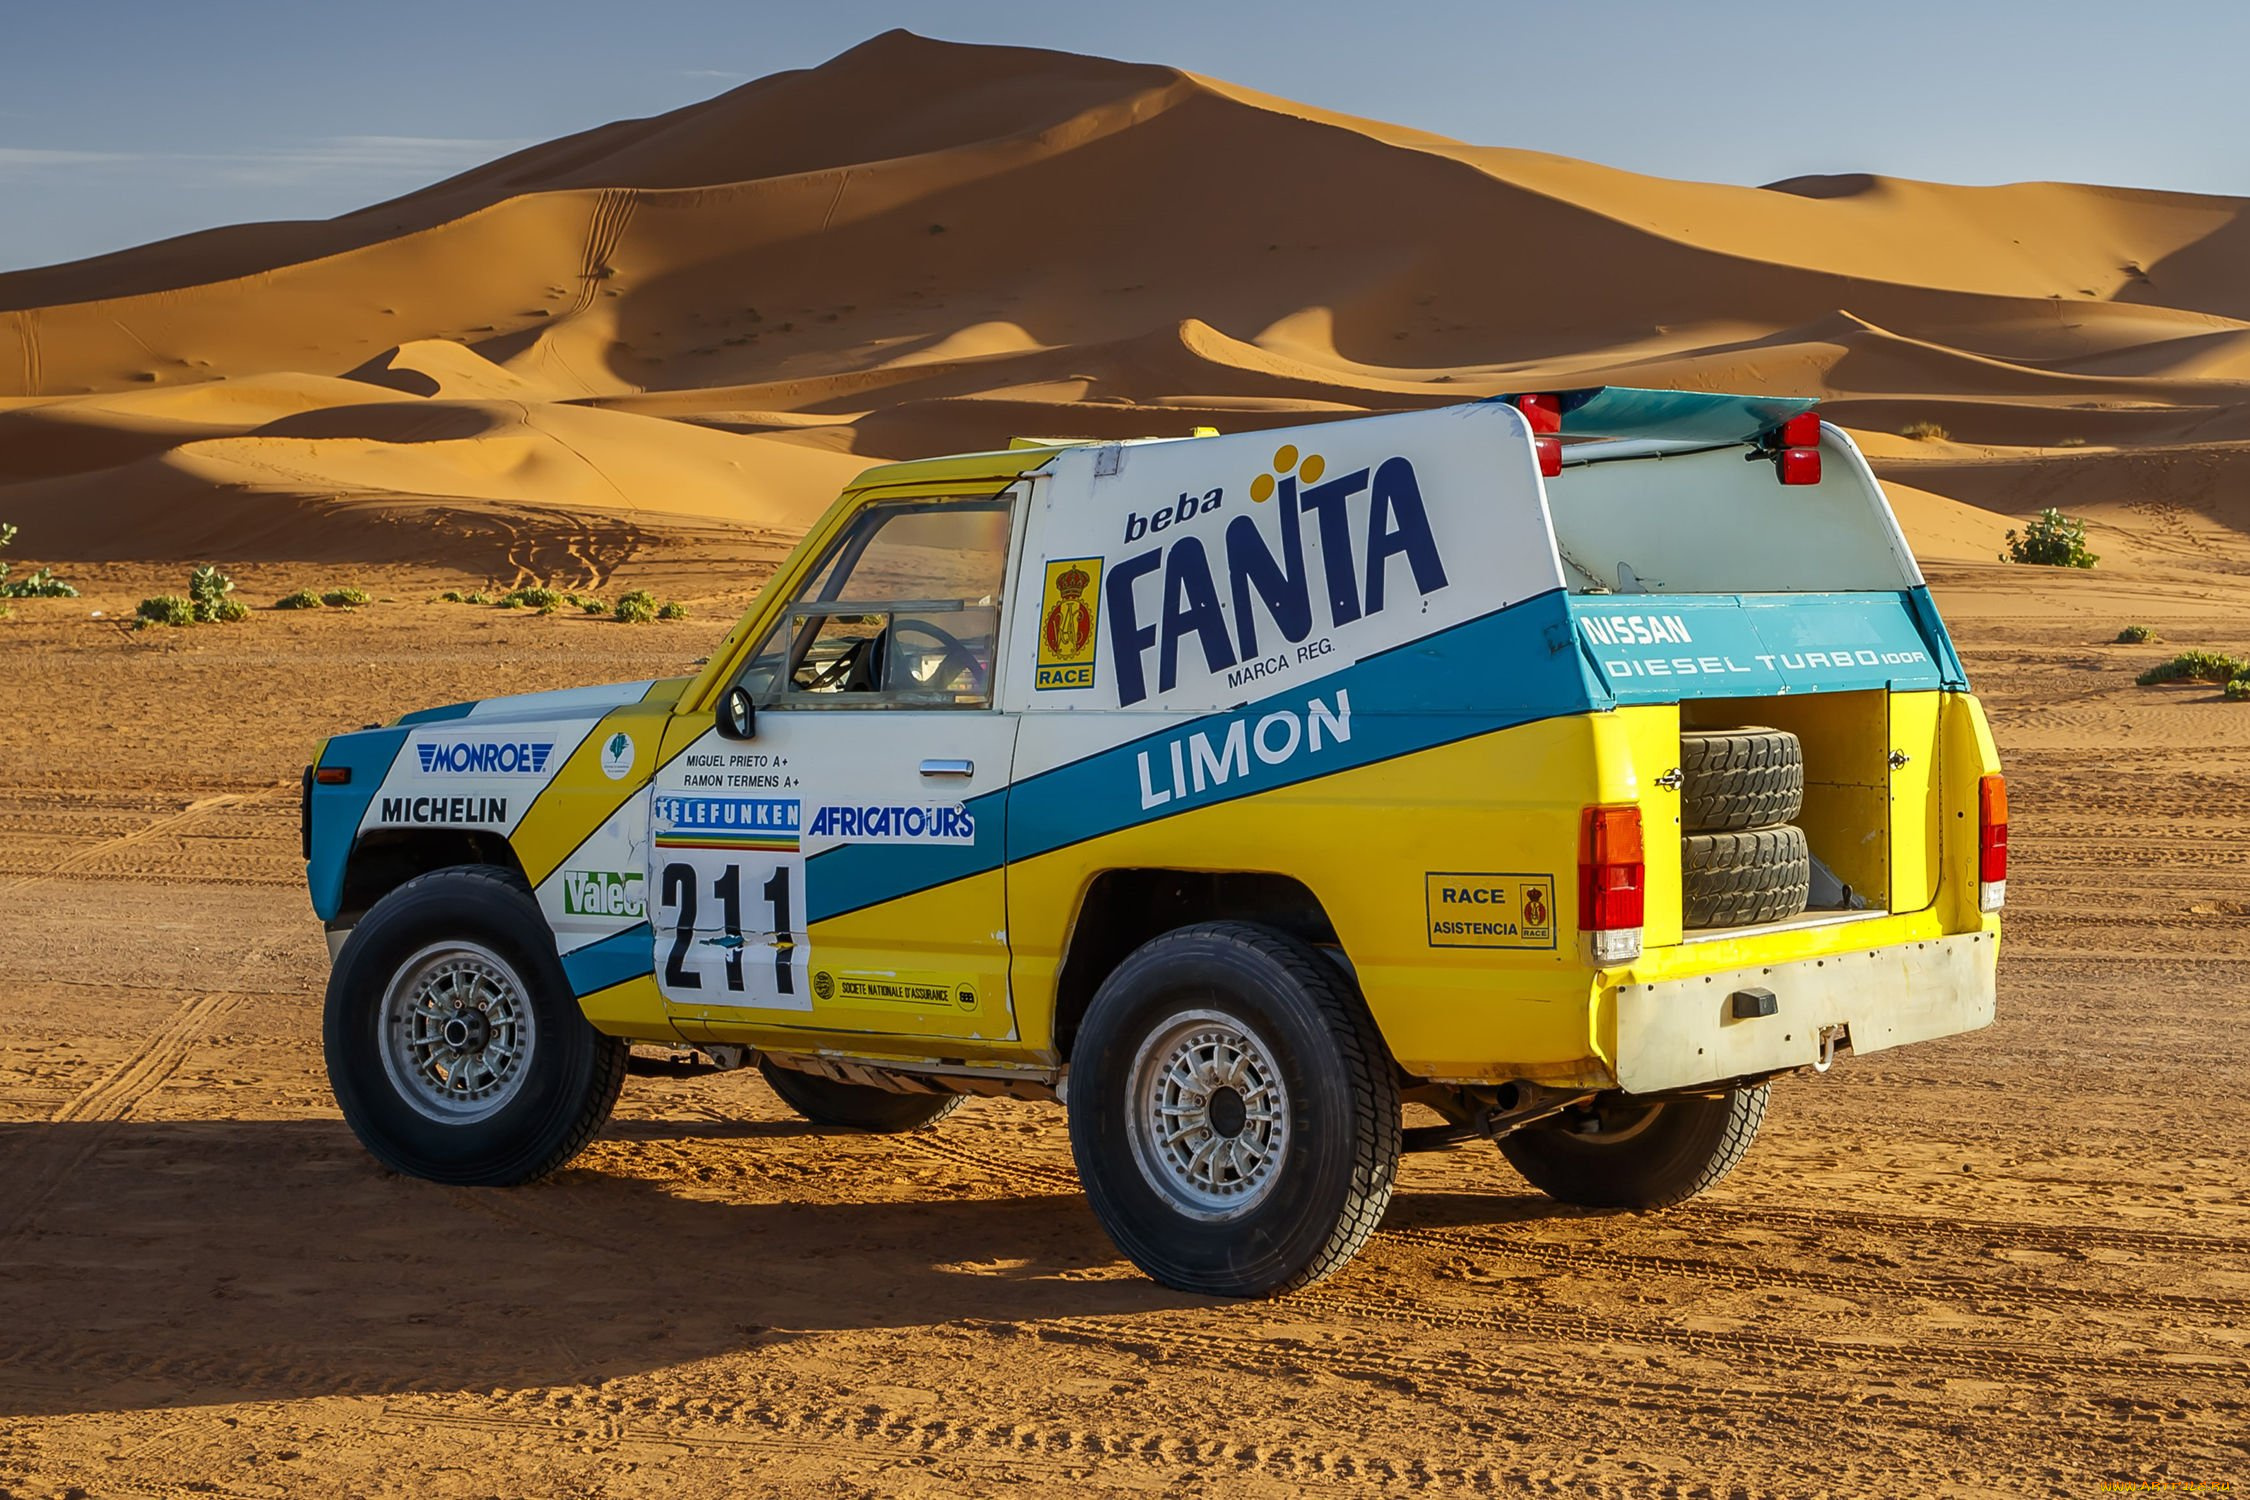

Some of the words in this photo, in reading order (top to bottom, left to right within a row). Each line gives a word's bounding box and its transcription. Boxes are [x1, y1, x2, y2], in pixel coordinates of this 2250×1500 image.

[1124, 487, 1224, 544] beba
[1105, 456, 1449, 708] FANTA
[1580, 615, 1693, 645] NISSAN
[1228, 655, 1290, 689] MARCA
[1297, 638, 1336, 663] REG.
[1605, 656, 1751, 677] DIESEL
[1755, 650, 1879, 671] TURBO
[1039, 669, 1090, 685] RACE
[431, 743, 532, 773] MONROE
[686, 755, 725, 767] MIGUEL
[729, 755, 768, 767] PRIETO
[772, 755, 788, 768] A+
[1137, 688, 1352, 811] LIMON
[684, 774, 723, 787] RAMON
[727, 775, 780, 788] TERMENS
[783, 776, 800, 788] A+
[381, 797, 507, 823] MICHELIN
[656, 801, 799, 826] TELEFUNKEN
[808, 806, 974, 838] AFRICATOURS
[1442, 888, 1506, 904] RACE
[661, 862, 795, 995] 211
[1433, 921, 1519, 935] ASISTENCIA
[1523, 928, 1547, 937] RACE
[842, 982, 867, 996] SOCIETE
[868, 985, 903, 999] NATIONALE
[904, 989, 950, 1002] D'ASSURANCE
